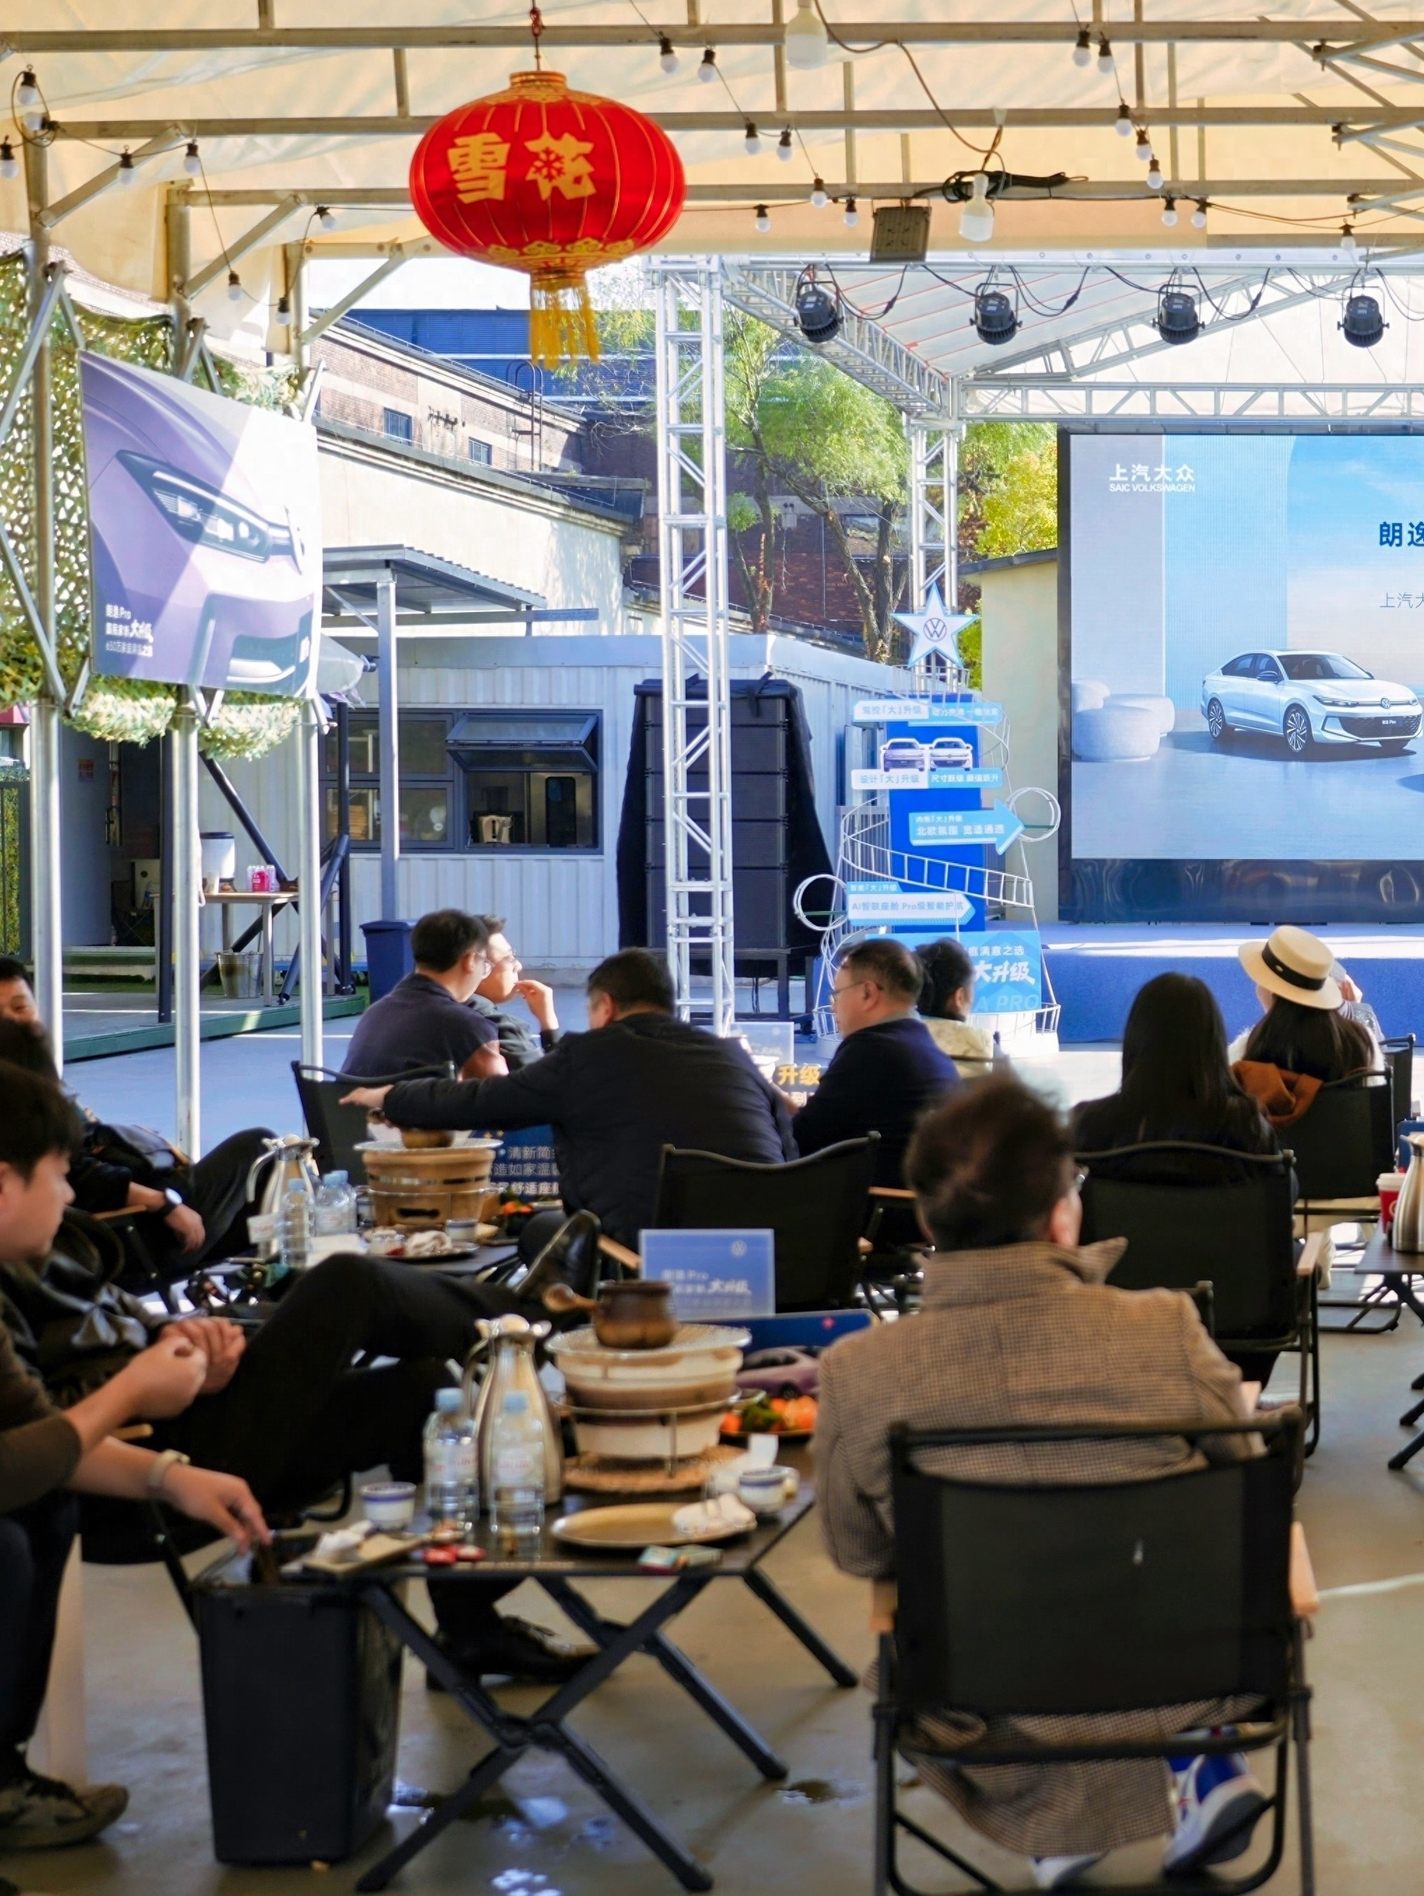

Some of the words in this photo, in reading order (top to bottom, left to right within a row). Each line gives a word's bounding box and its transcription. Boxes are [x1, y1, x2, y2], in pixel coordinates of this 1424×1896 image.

[1109, 463, 1195, 482] 上汽大众
[1109, 483, 1130, 493] SAIC
[1132, 483, 1195, 493] VOLKSWAGEN
[997, 993, 1040, 1010] PRO
